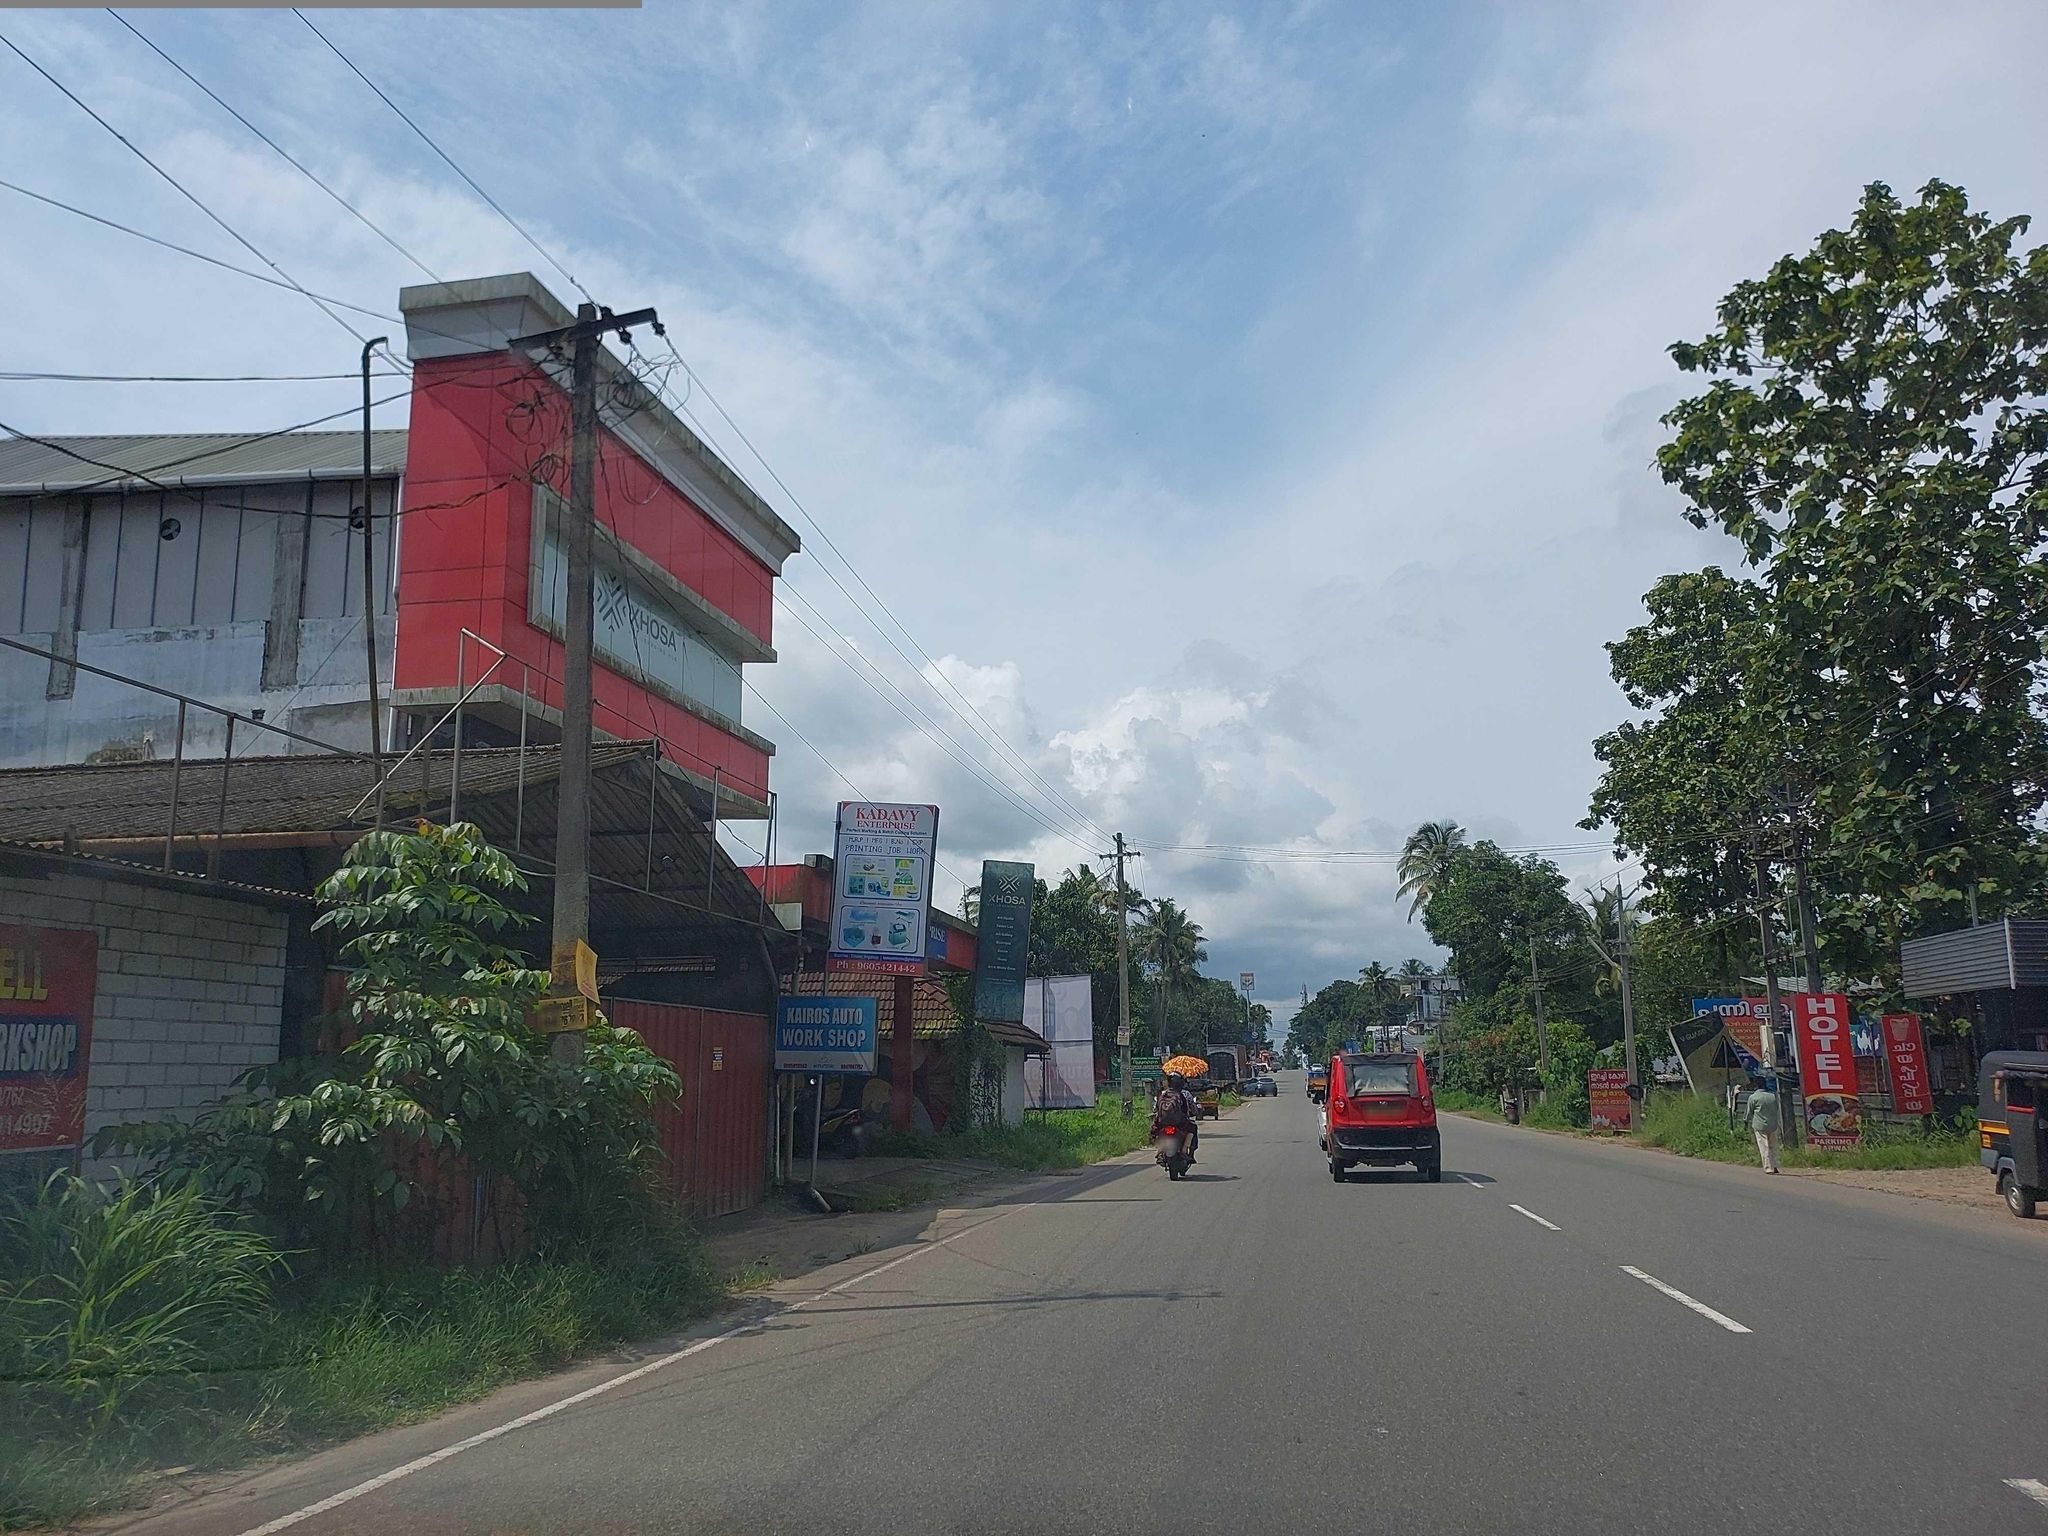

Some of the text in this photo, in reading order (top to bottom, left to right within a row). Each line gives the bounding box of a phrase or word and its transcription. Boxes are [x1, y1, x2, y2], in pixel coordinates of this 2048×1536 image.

[630, 605, 677, 651] XHOSA
[856, 807, 920, 822] KADAVY
[857, 820, 916, 830] ENTERPRISE
[845, 844, 882, 853] PRINTING
[887, 846, 902, 855] JOB
[989, 894, 1026, 905] XHOSA
[836, 960, 849, 969] Ph
[857, 961, 916, 974] 9605421442
[787, 1007, 863, 1025] KAIROS AUTO
[783, 1028, 867, 1048] WORK SHOP
[1806, 998, 1843, 1090] HOTEL
[1814, 1137, 1852, 1146] PARKING
